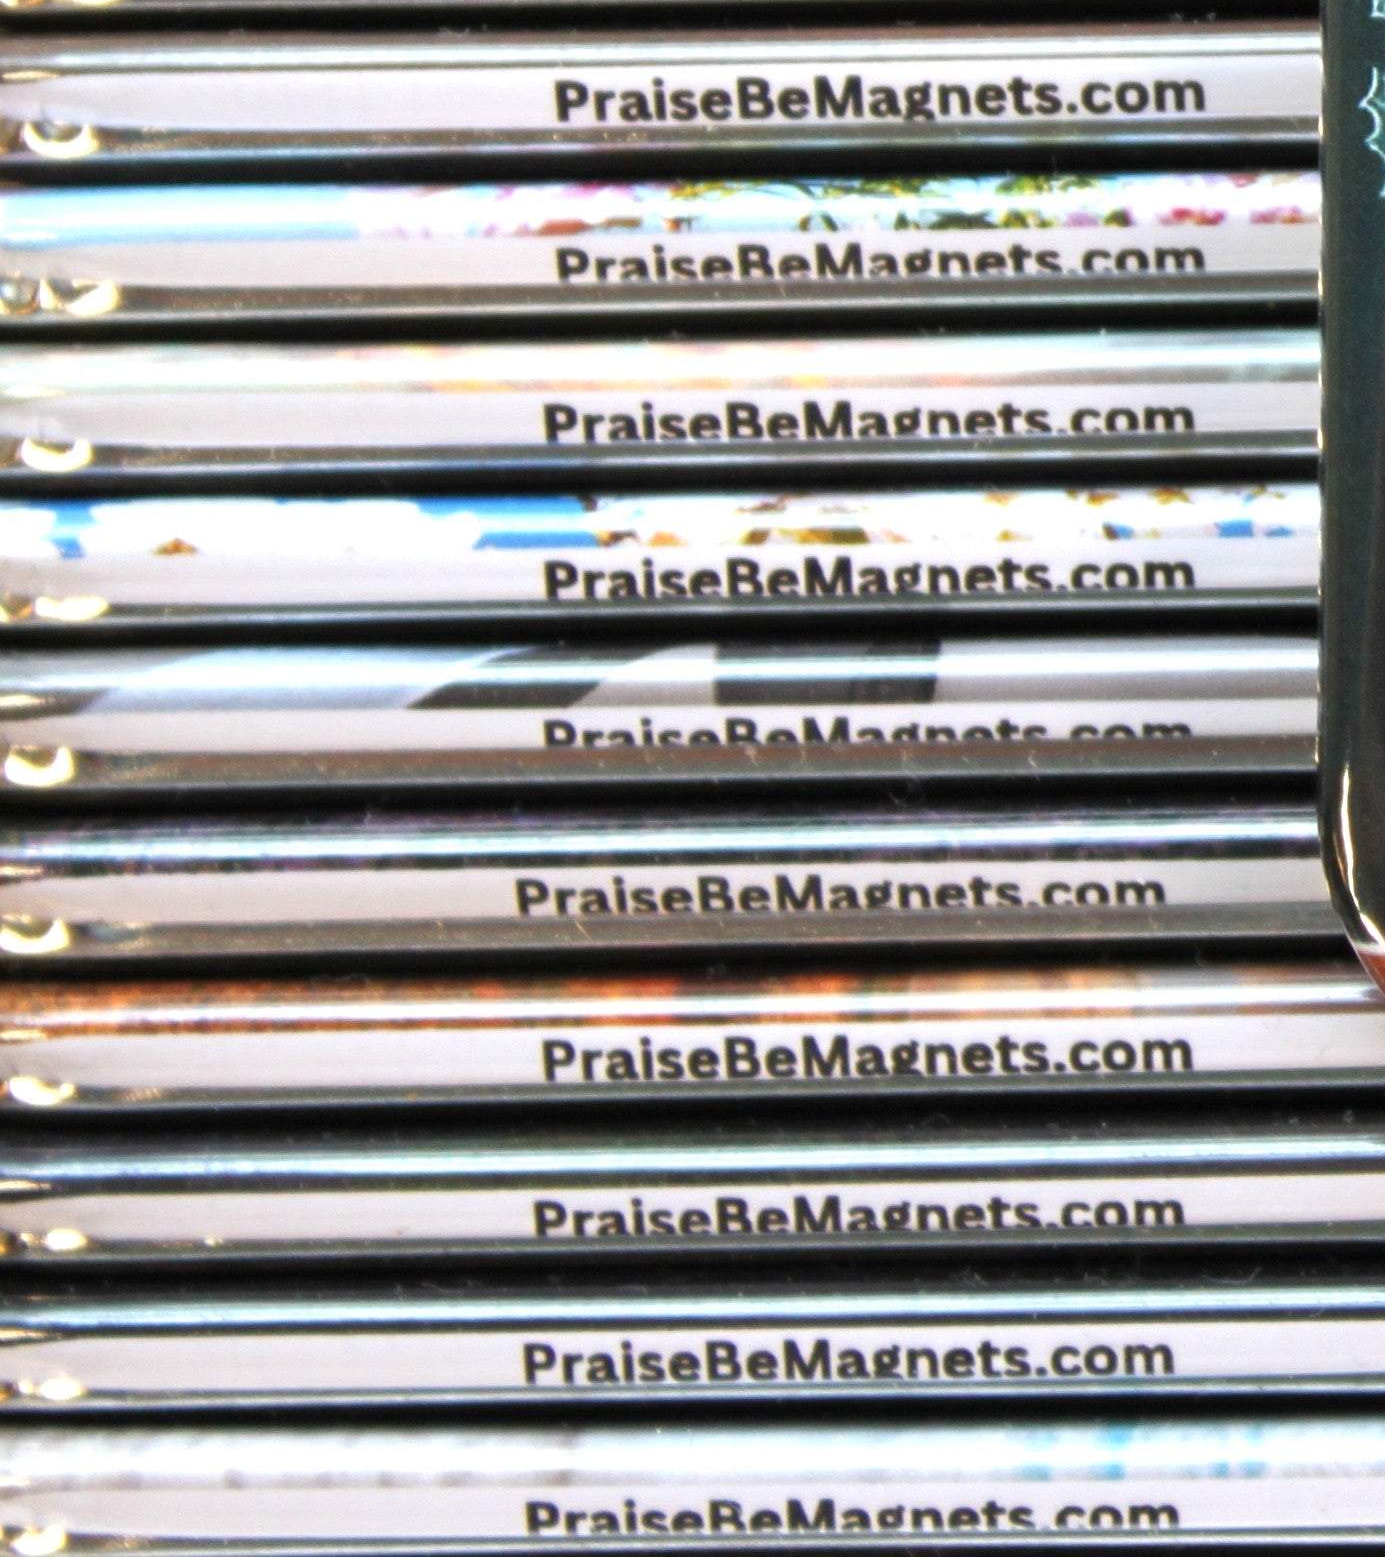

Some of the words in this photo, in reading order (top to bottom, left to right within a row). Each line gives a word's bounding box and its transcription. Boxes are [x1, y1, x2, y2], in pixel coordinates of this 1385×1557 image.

[554, 74, 1204, 122] PraiseBeMagnets.com
[544, 400, 1193, 444] PraiseBeMagnets.com
[544, 555, 1193, 602] PraiseBeMagnets.com
[544, 717, 1192, 748] PraiseBeMagnetscom
[515, 875, 1165, 917] PraiseBeMagnets.com
[543, 1032, 1192, 1082] PraiseBeMagnets.com
[533, 1194, 1184, 1238] PraiseBeMagnets.com
[522, 1337, 1174, 1385] PraiseBeMagnets.com
[525, 1498, 1179, 1536] PraiseBeMagnetscom
